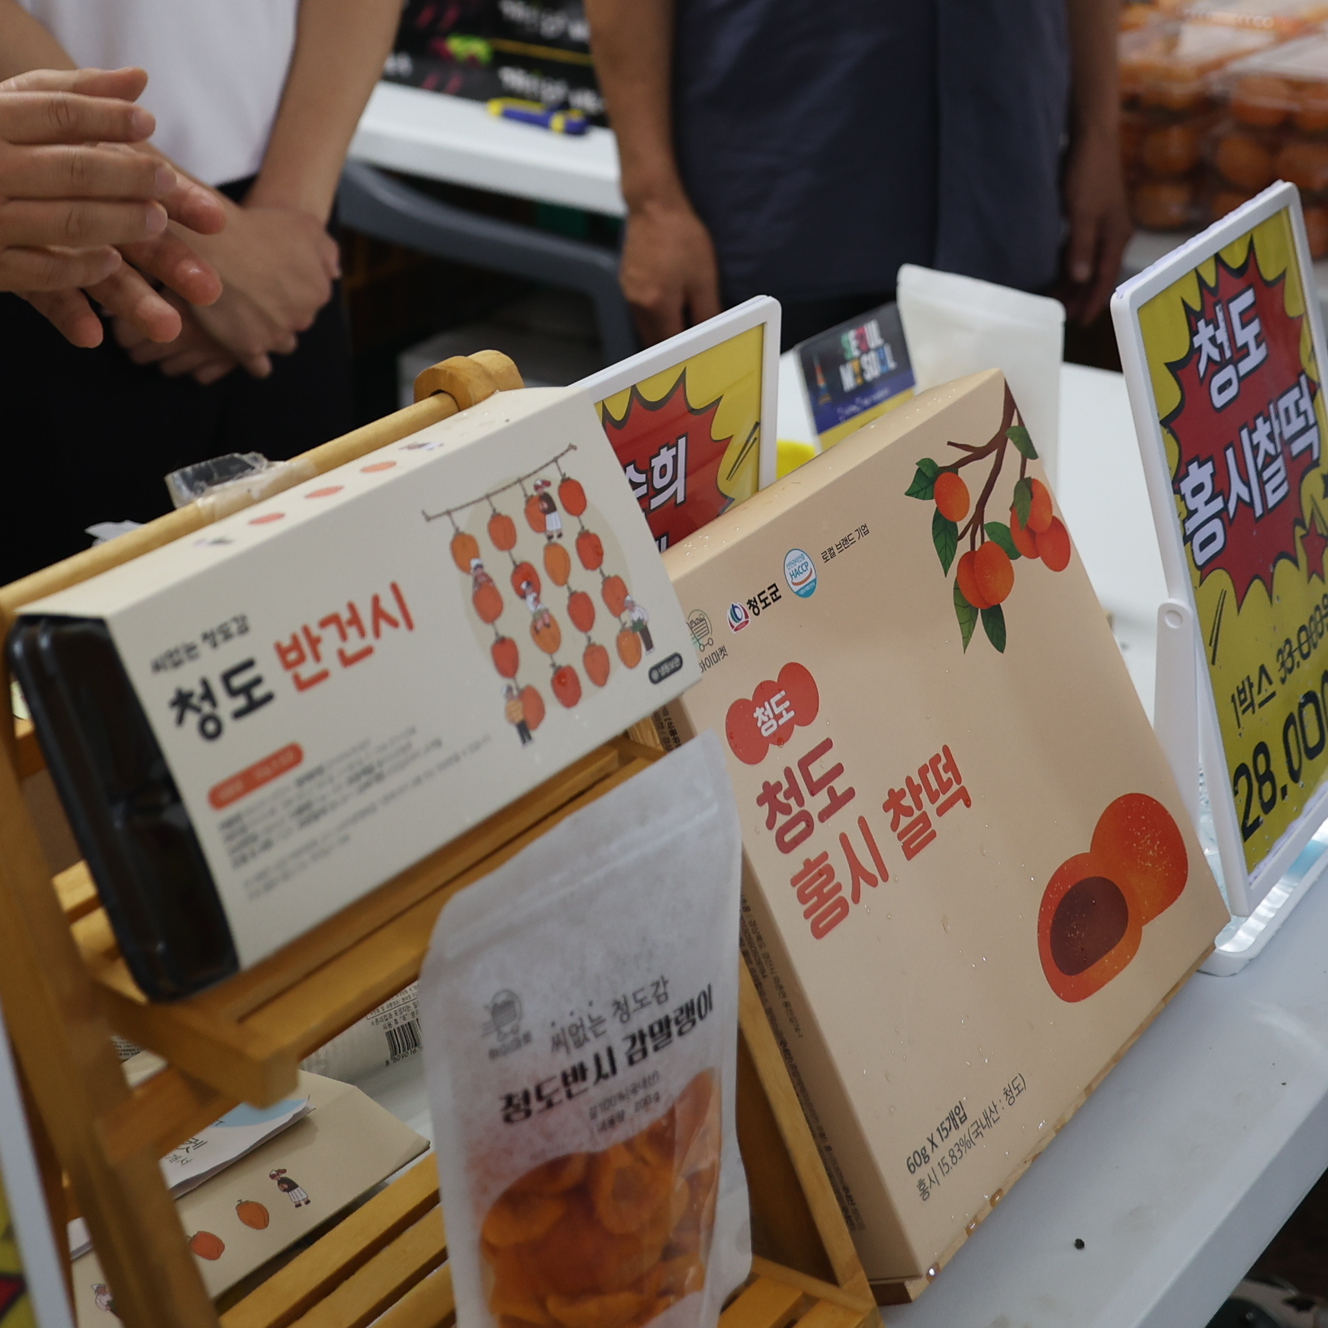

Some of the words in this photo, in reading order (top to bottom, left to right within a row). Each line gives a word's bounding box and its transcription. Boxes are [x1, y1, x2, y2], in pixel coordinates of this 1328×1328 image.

[1192, 286, 1268, 410] 청도
[1179, 373, 1320, 567] 홍시찰떡
[788, 561, 810, 580] HACCP
[835, 534, 856, 553] 브랜드
[855, 523, 870, 542] 기업
[746, 583, 782, 616] 청도군
[169, 657, 275, 742] 청도
[274, 581, 415, 693] 반건시
[1231, 664, 1277, 729] 1박스
[753, 690, 795, 737] 청도
[756, 737, 856, 854] 청도
[790, 815, 890, 940] 홍시
[882, 744, 972, 861] 찰떡
[500, 1046, 618, 1124] 청도반시
[622, 982, 714, 1067] 감말랭이
[551, 1012, 607, 1056] 씨없는
[612, 974, 669, 1024] 청도감
[906, 1146, 931, 1174] 60g
[936, 1100, 968, 1142] 15개입
[916, 1167, 941, 1202] 홍시
